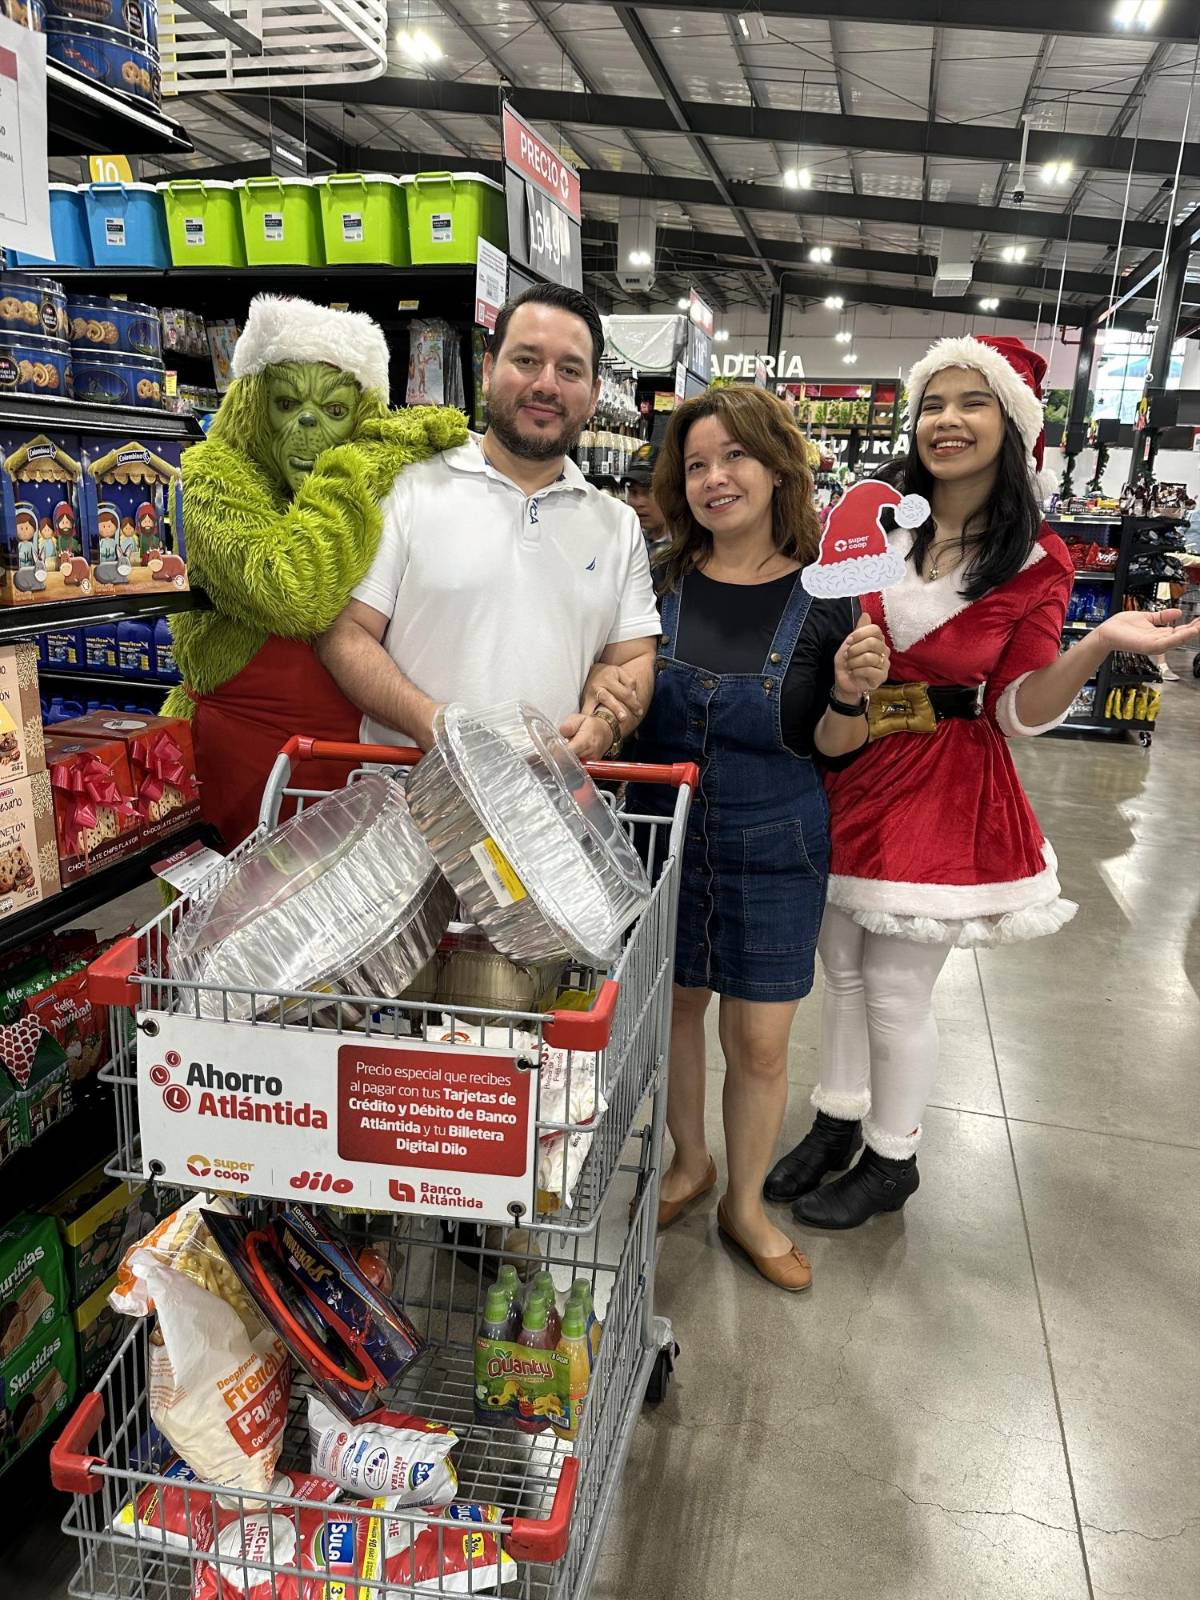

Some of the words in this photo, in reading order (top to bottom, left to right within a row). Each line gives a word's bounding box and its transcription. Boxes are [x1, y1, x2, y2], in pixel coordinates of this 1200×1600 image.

[520, 131, 559, 188] PRECIO
[847, 535, 870, 545] super
[848, 542, 868, 551] coop
[50, 998, 92, 1032] Navidad
[53, 997, 76, 1014] Feliz
[186, 1061, 283, 1096] Ahorro
[356, 1061, 392, 1077] Precio
[394, 1067, 442, 1081] especial
[443, 1071, 467, 1084] que
[469, 1073, 511, 1087] recibes
[350, 1080, 360, 1092] al
[362, 1084, 396, 1097] pagar
[398, 1085, 420, 1097] con
[422, 1087, 441, 1099] tus
[443, 1087, 496, 1104] Tarjetas
[498, 1092, 516, 1106] de
[197, 1091, 329, 1129] Atlántida
[348, 1097, 396, 1114] Crédito
[398, 1104, 407, 1116] y
[409, 1102, 454, 1119] Débito
[456, 1107, 473, 1120] de
[475, 1109, 517, 1125] Banco
[360, 1116, 421, 1134] Atlántida
[422, 1125, 431, 1137] y
[434, 1125, 446, 1136] tu
[448, 1125, 504, 1142] Billetera
[396, 1138, 439, 1154] Digital
[441, 1142, 468, 1156] Dilo
[213, 1157, 256, 1172] super
[213, 1169, 250, 1184] coop
[289, 1170, 354, 1194] dilo
[420, 1181, 462, 1196] Banco
[420, 1194, 484, 1209] Atlántida
[9, 1336, 62, 1397] Surtidas
[222, 1351, 281, 1412] French
[237, 1383, 282, 1435] Papas
[391, 1455, 402, 1491] ENTERA
[398, 1461, 408, 1489] LECHE
[254, 1524, 269, 1563] LECHE
[328, 1523, 348, 1561] SULA
